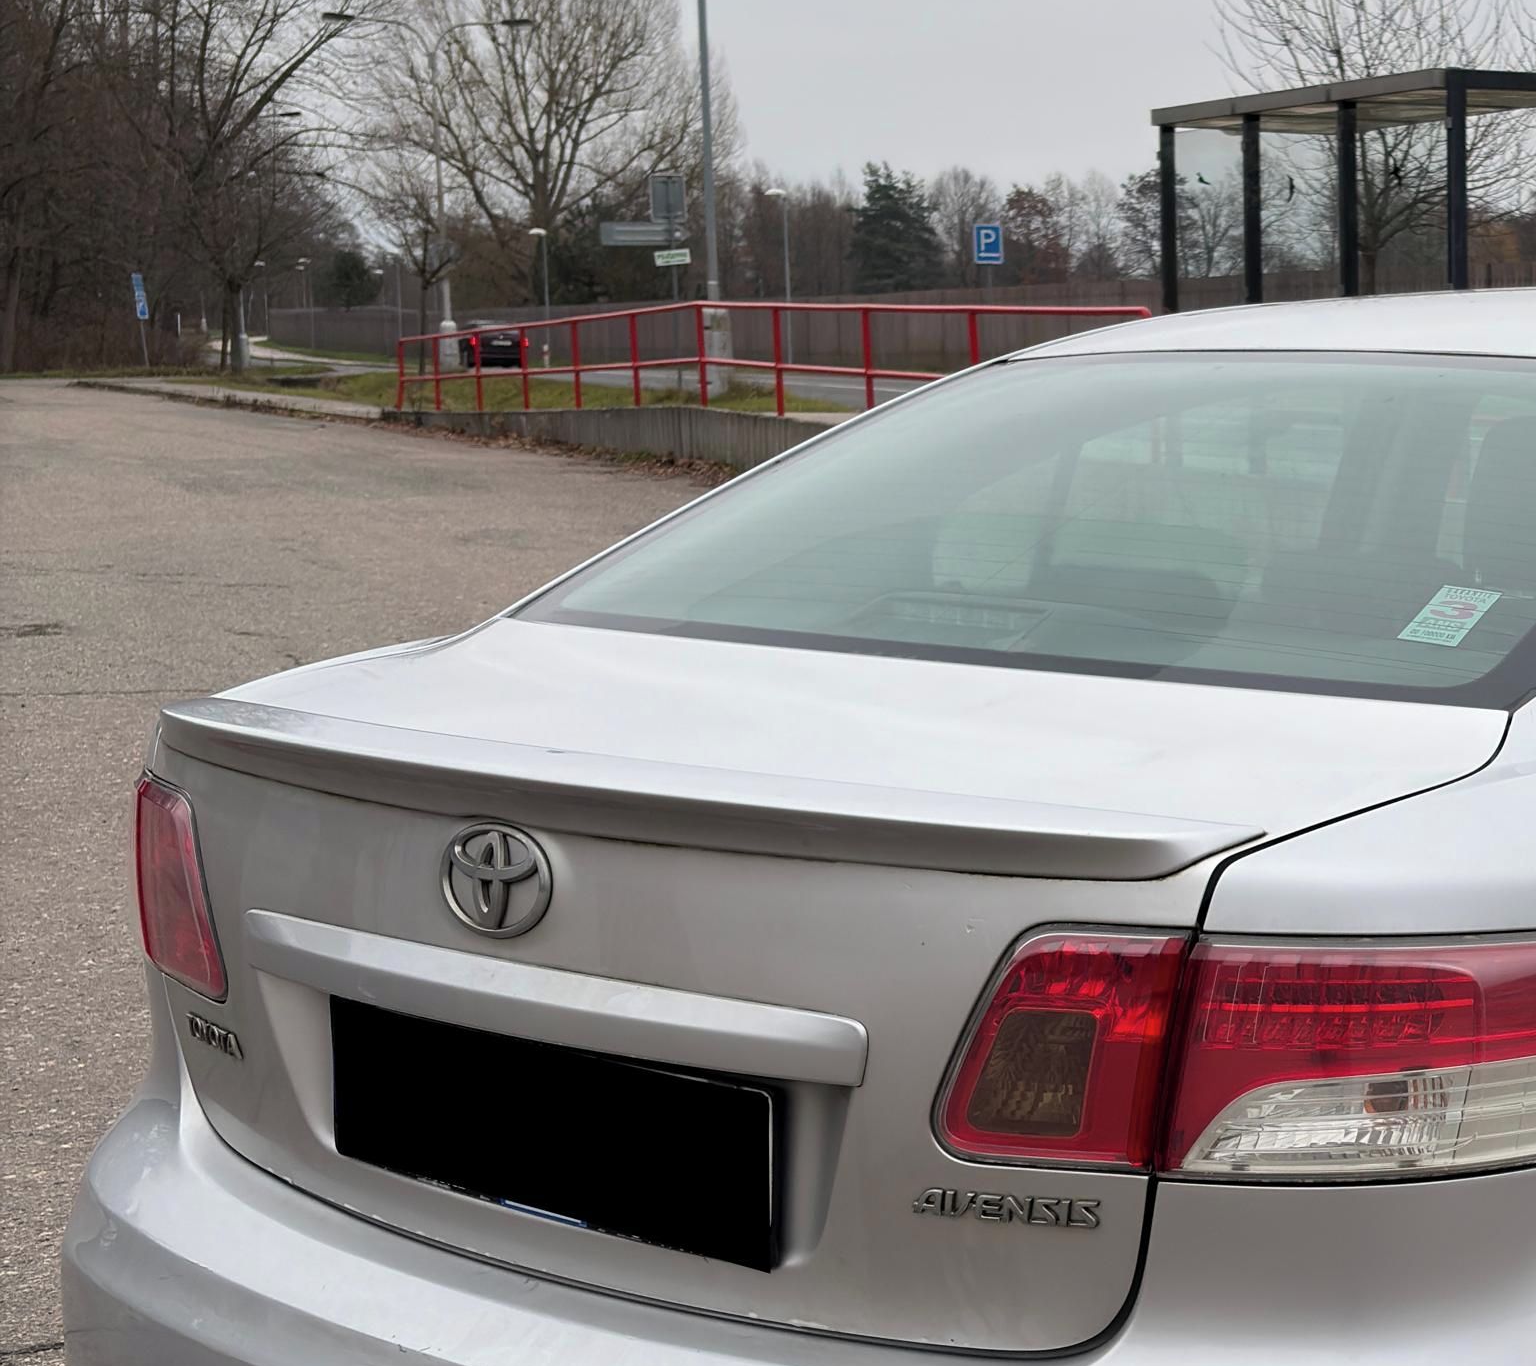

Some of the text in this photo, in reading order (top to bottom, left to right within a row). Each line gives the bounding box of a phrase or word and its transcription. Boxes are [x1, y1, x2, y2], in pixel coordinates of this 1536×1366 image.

[980, 229, 996, 252] P
[1429, 600, 1479, 620] 3
[186, 1011, 244, 1060] TOYOTA
[912, 1187, 1100, 1228] AVENSIS
